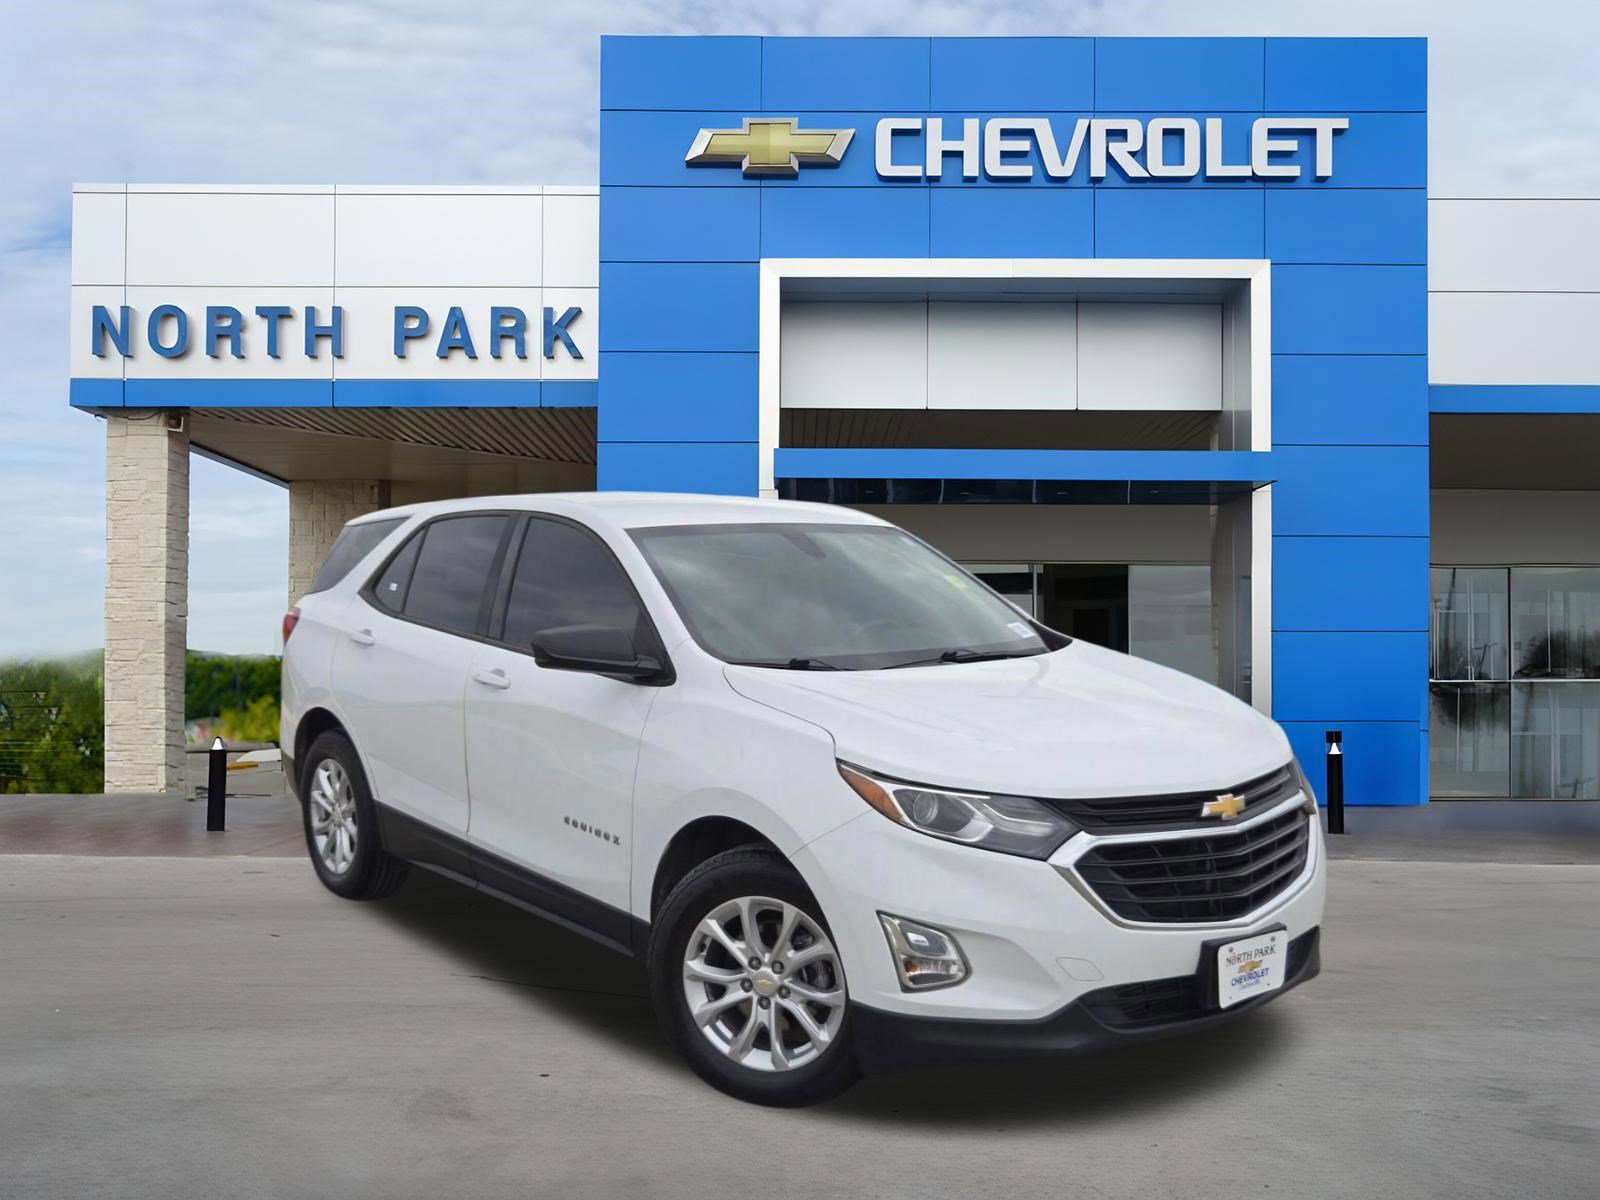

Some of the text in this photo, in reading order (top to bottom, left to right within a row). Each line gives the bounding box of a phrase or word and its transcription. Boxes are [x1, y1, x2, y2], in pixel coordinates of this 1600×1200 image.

[875, 117, 1350, 179] CHEVROLET
[91, 304, 585, 361] NORTH PARK
[1225, 944, 1276, 967] NORTH PARK
[1231, 967, 1270, 987] CHEVROLET
